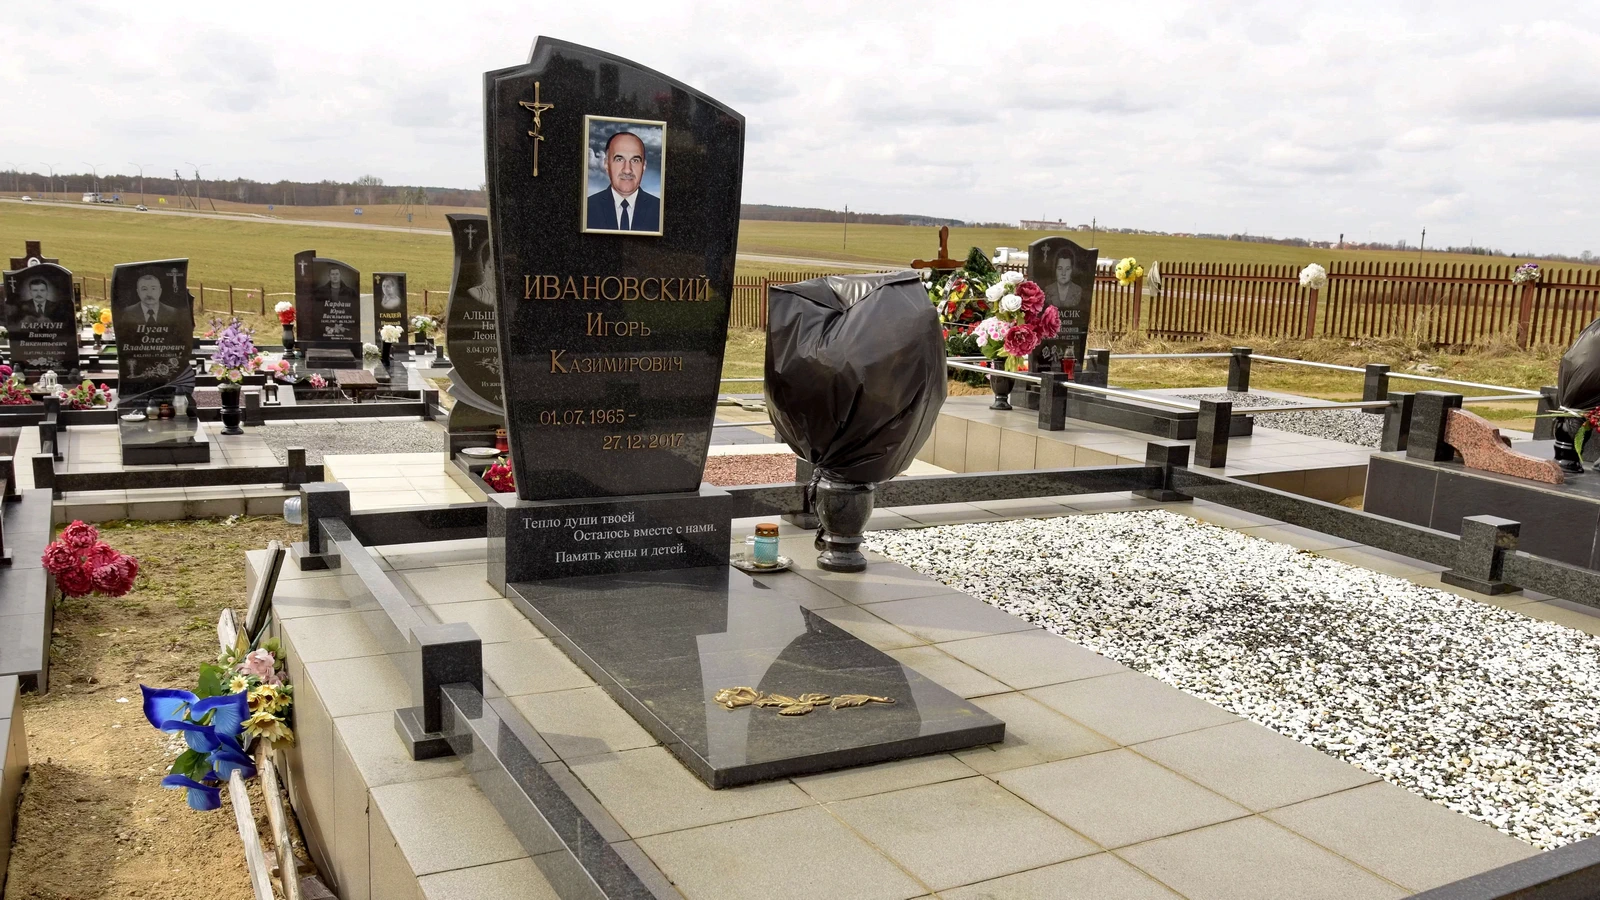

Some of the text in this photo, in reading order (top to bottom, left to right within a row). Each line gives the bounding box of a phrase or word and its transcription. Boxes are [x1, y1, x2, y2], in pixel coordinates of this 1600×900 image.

[523, 274, 710, 302] ИВАНОВСКИЙ
[462, 310, 496, 321] АЛЬШ
[136, 324, 169, 335] Пугач
[482, 320, 496, 331] На
[585, 312, 651, 337] Игорь
[28, 331, 57, 339] Виктор
[141, 335, 165, 344] Олег
[472, 330, 497, 341] Леон
[122, 343, 186, 353] Владимирович
[550, 349, 683, 374] Казимирович
[602, 433, 685, 450] 27.12.2017
[522, 512, 636, 531] Тепло души твоей
[573, 523, 718, 542] Осталось вместе с нами.
[555, 543, 687, 564] Память жены и детей.
